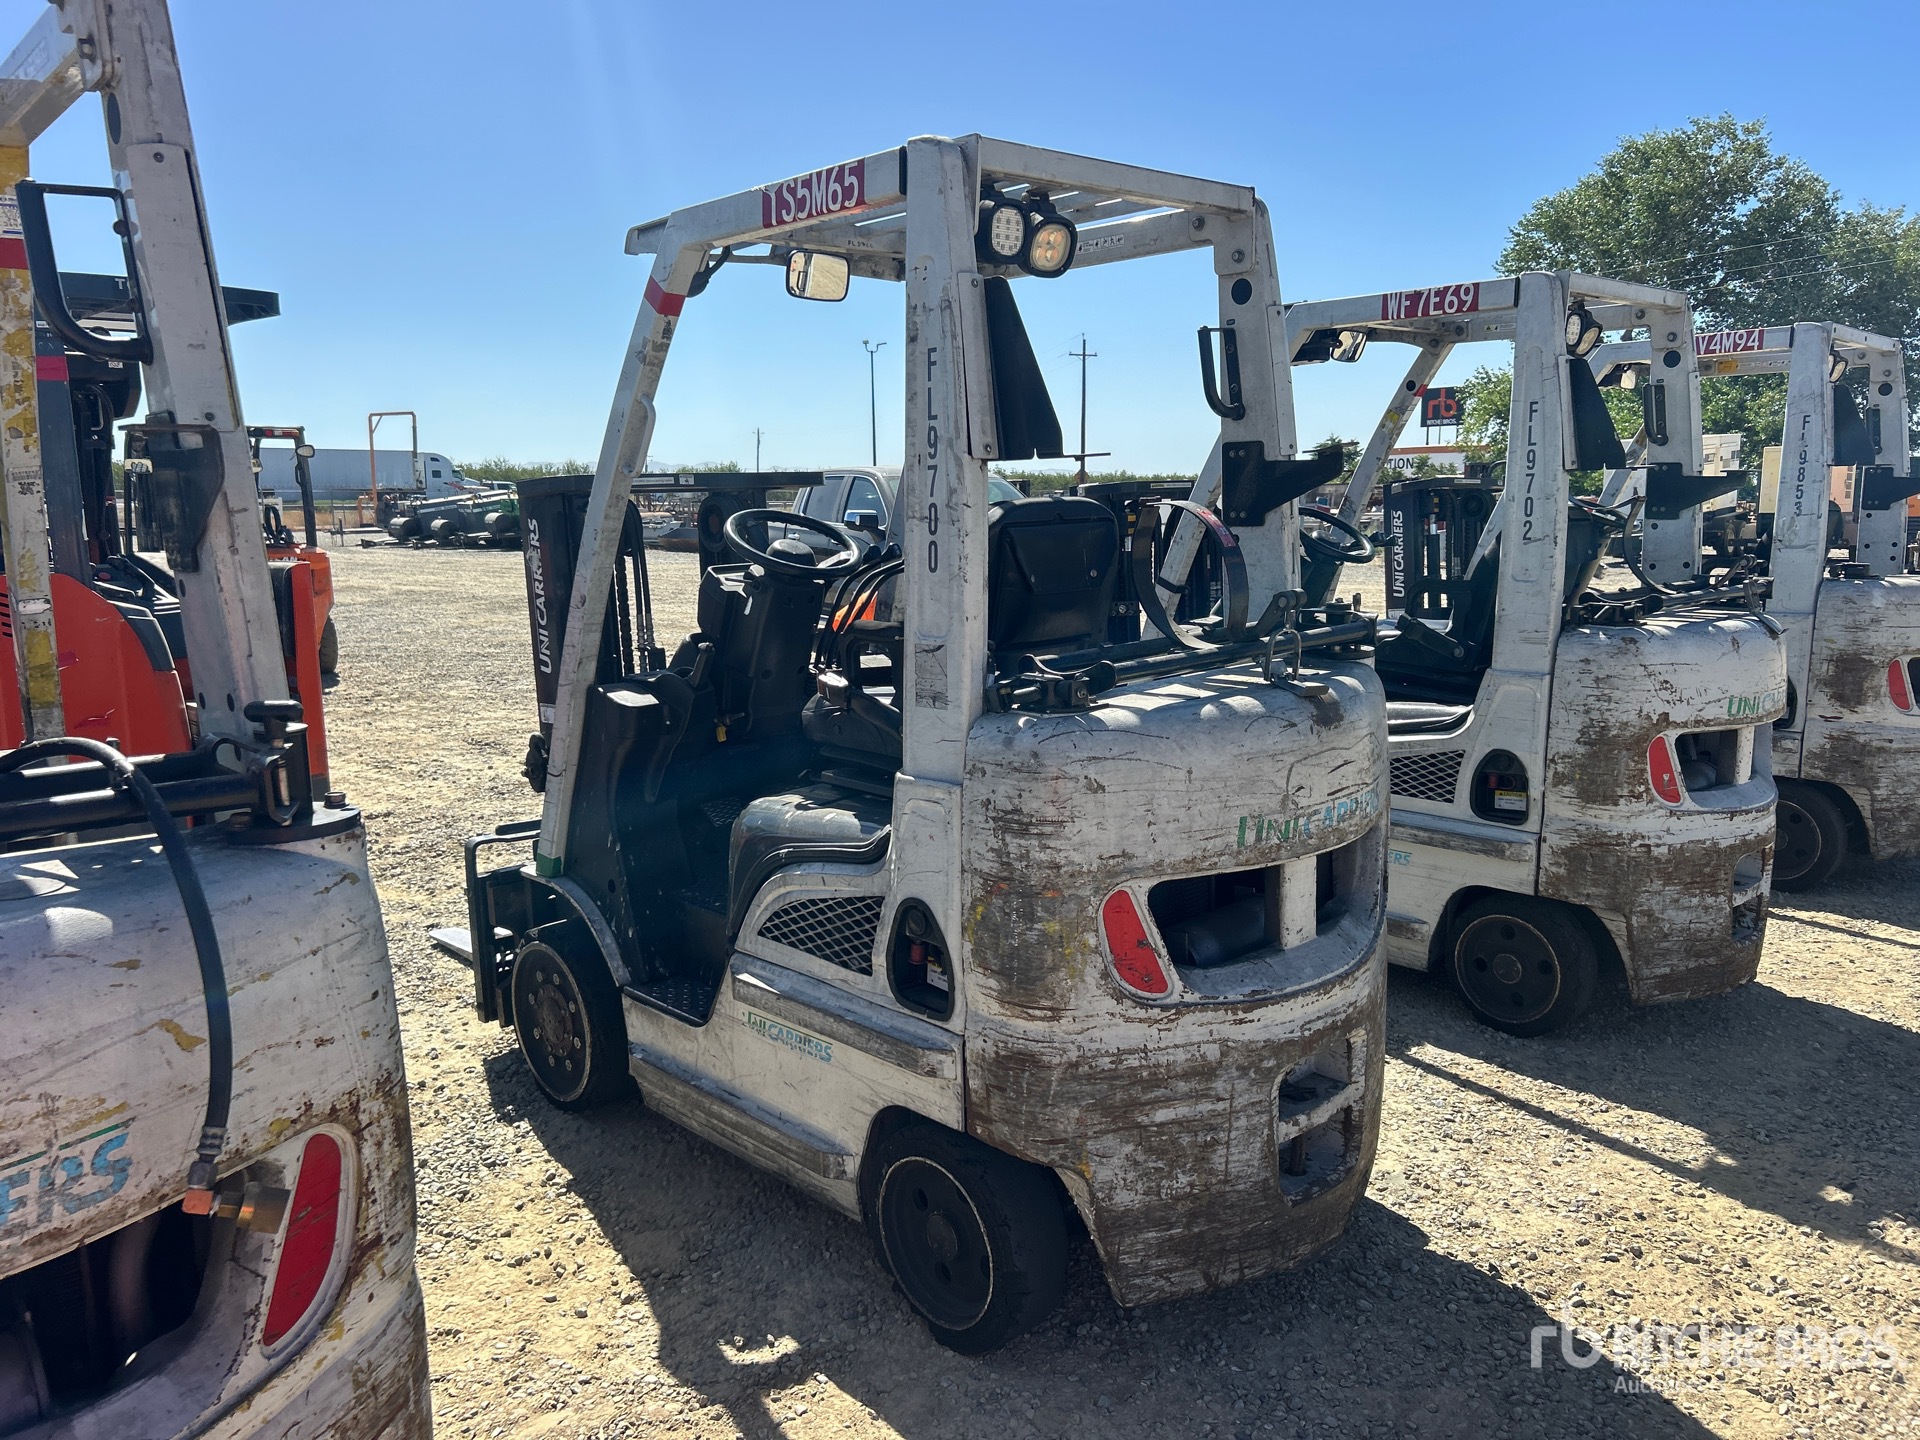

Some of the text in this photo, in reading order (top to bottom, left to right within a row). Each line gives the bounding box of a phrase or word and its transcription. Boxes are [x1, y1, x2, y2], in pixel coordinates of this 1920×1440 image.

[764, 162, 859, 226] YS5M65
[1387, 283, 1475, 320] WF7E69
[1698, 330, 1760, 355] V4M94
[1427, 388, 1458, 419] rb
[927, 347, 939, 574] FL9700
[1522, 401, 1539, 541] FL9702
[1392, 509, 1406, 599] UNICARRIERS
